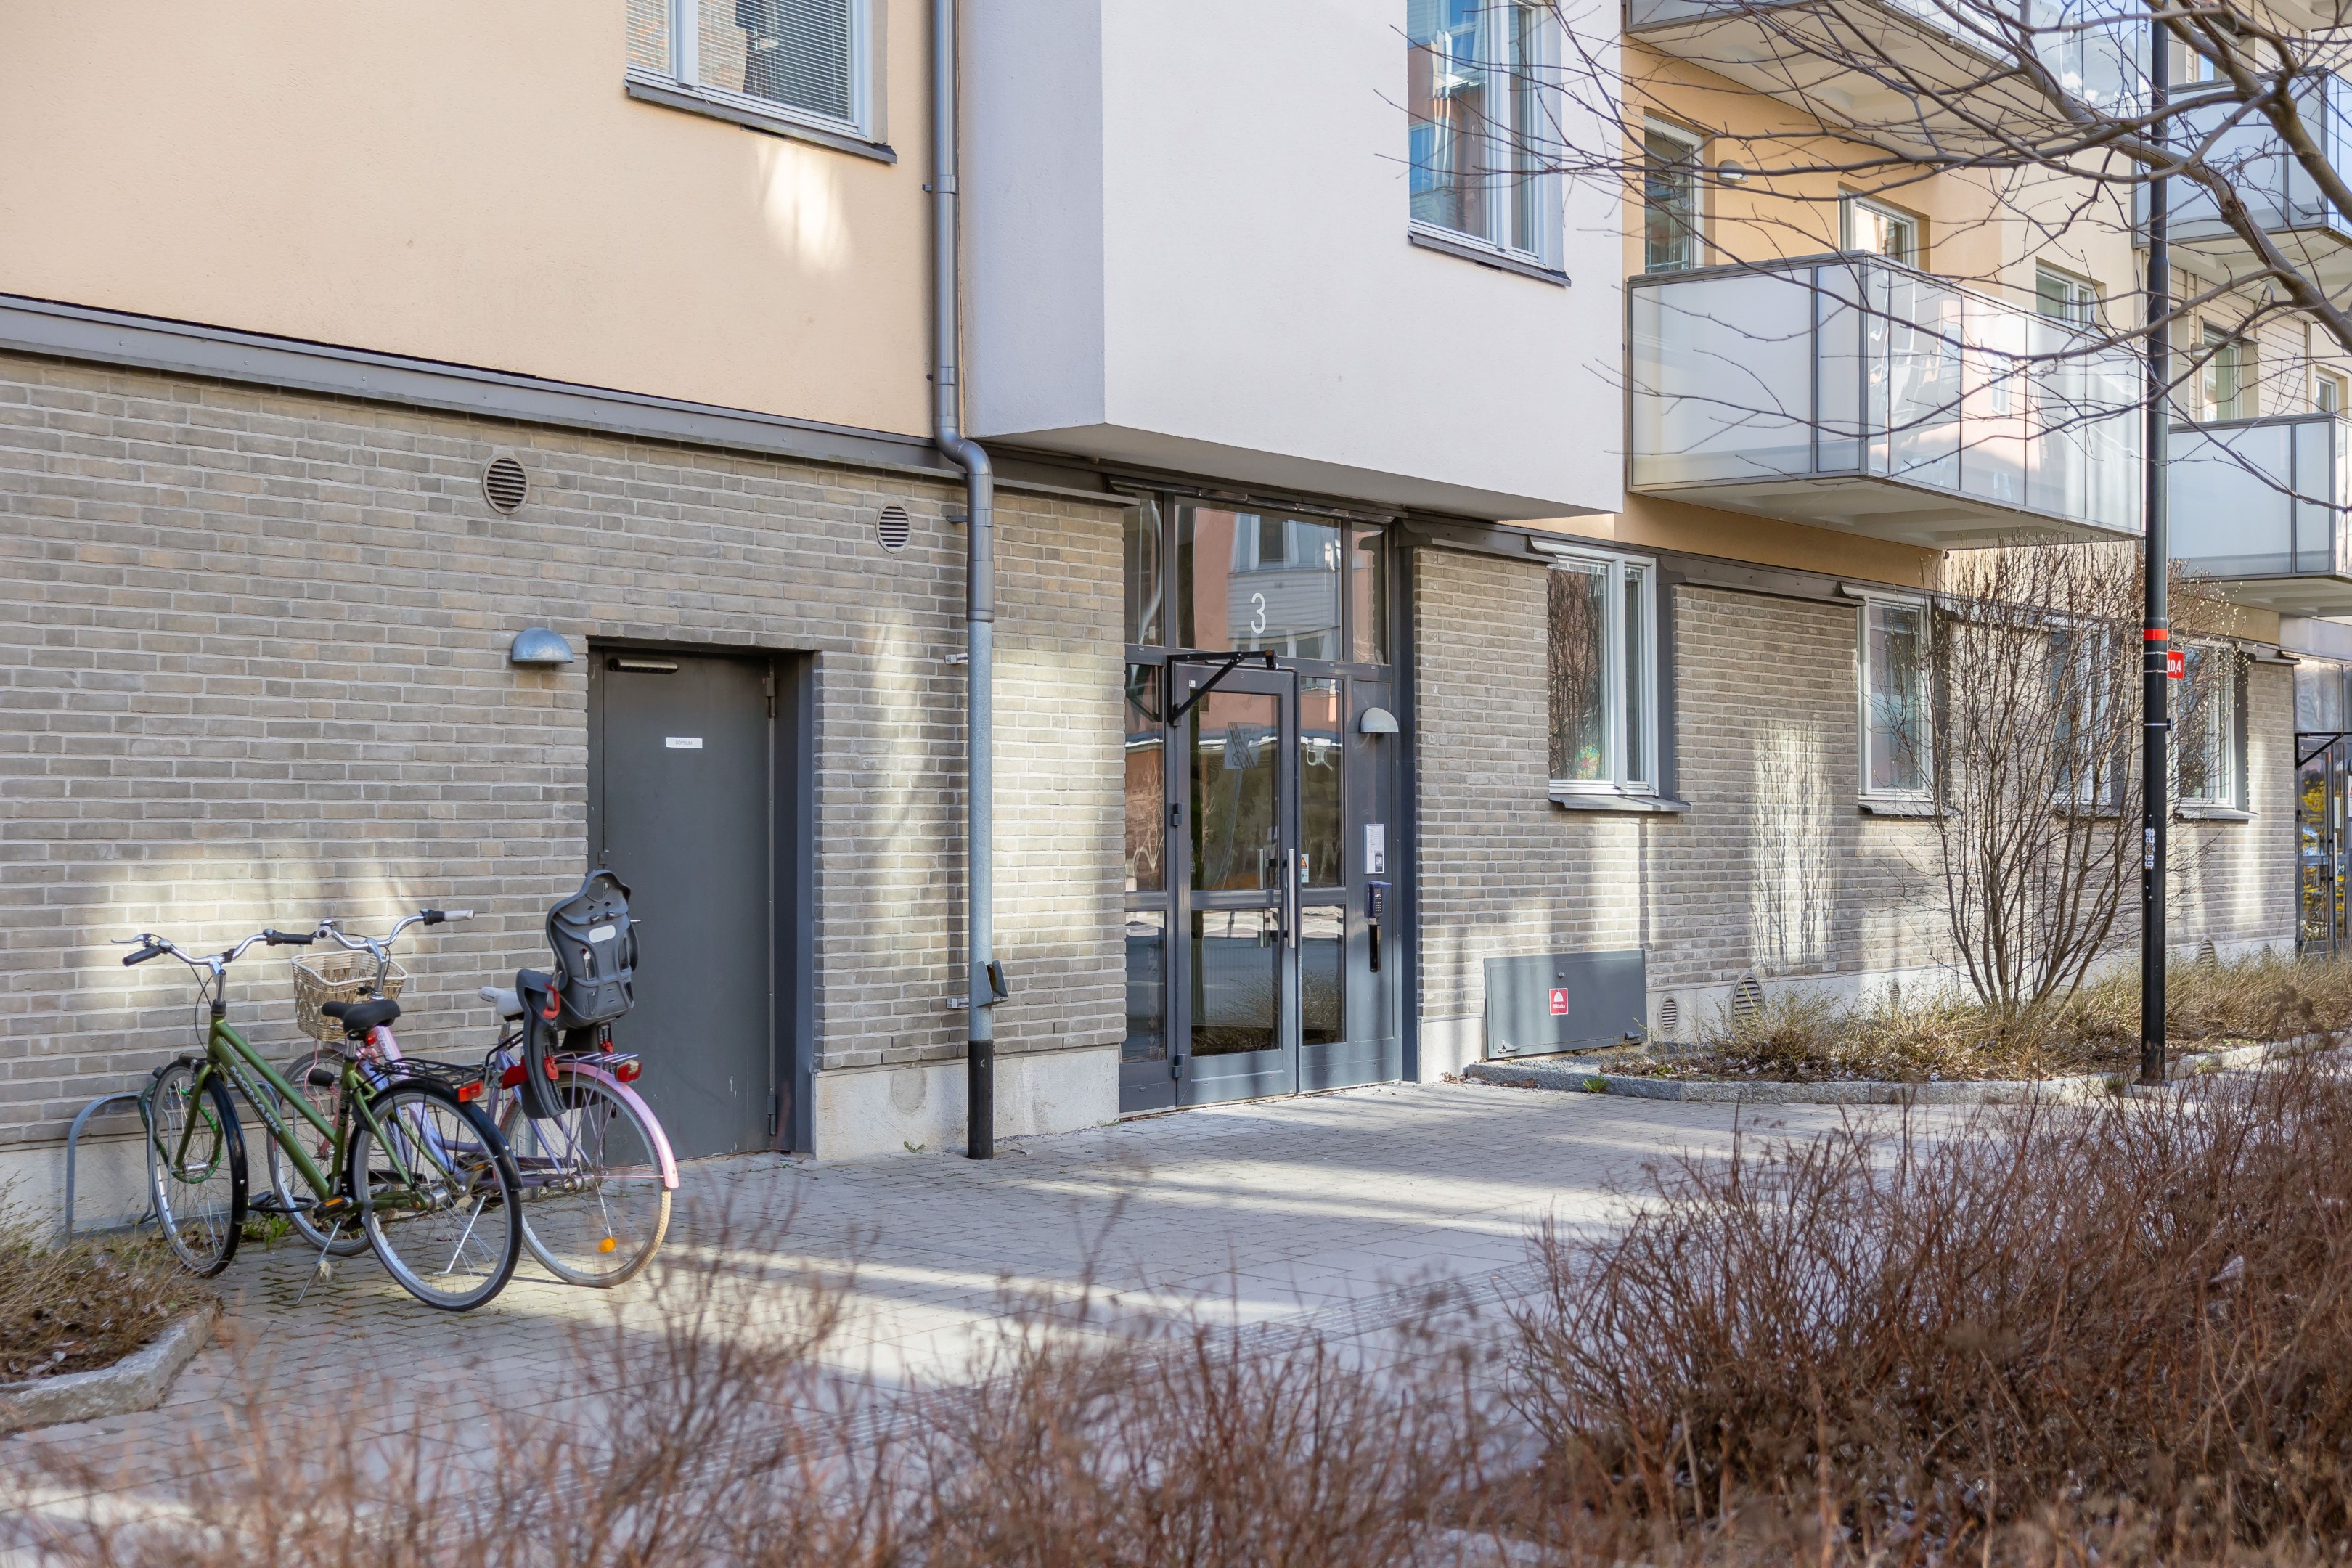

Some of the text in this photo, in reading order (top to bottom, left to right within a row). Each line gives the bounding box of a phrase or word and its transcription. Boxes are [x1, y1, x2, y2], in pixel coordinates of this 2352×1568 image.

[1251, 592, 1266, 634] 3
[2167, 659, 2181, 675] 10,4
[230, 1066, 282, 1134] MONARK
